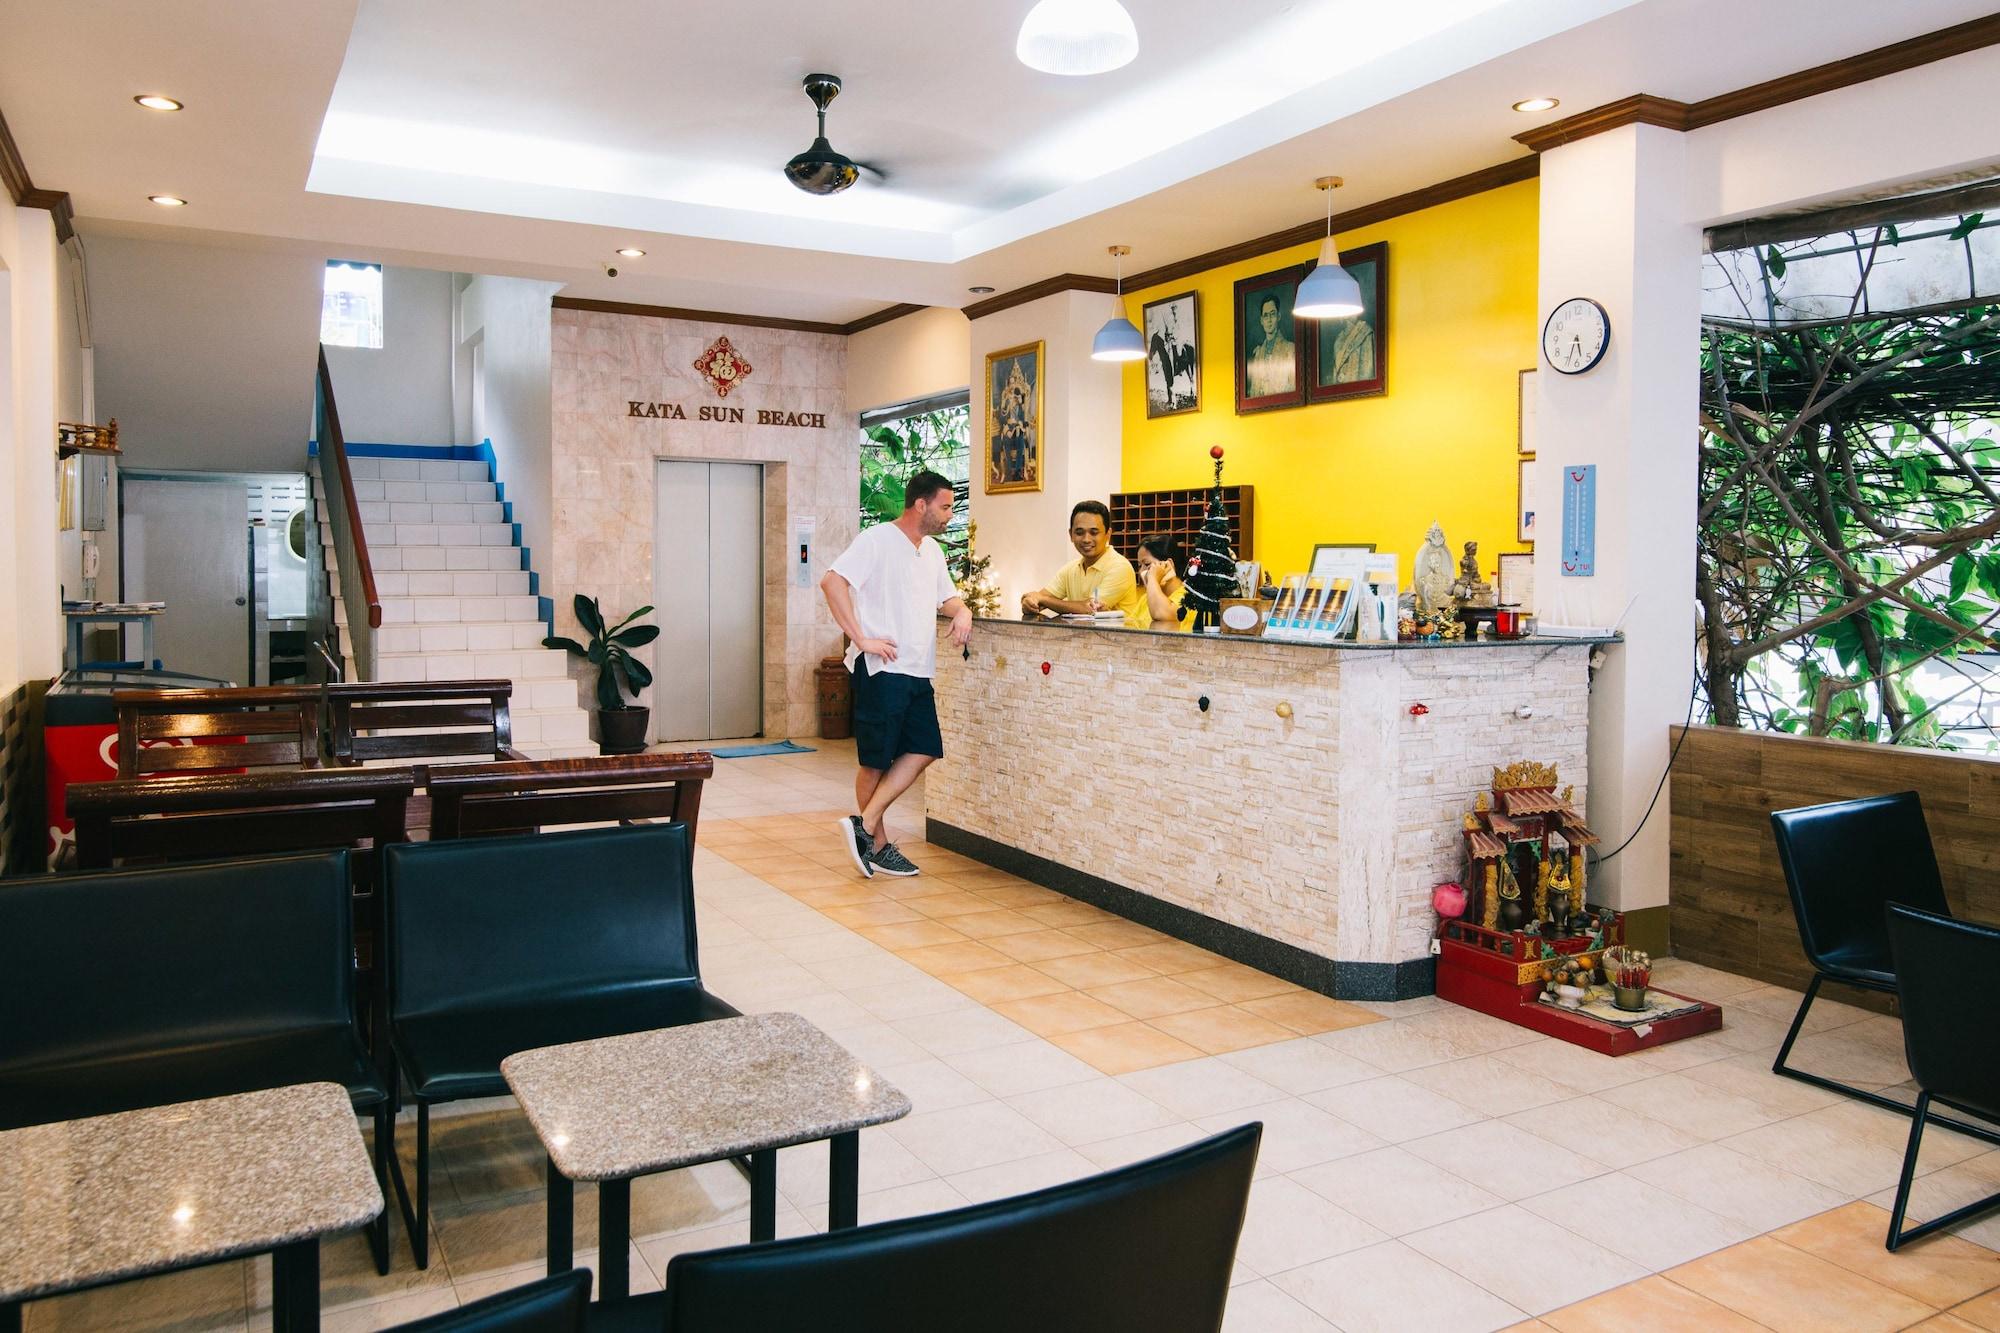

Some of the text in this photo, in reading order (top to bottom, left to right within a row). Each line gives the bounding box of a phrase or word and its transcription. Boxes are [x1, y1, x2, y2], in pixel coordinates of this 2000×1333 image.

[1565, 310, 1571, 320] 11
[1574, 305, 1582, 315] 12
[1556, 321, 1563, 331] 10
[1597, 328, 1602, 338] 3
[1553, 335, 1559, 345] 9
[1595, 342, 1600, 350] 4
[1555, 348, 1560, 357] 8
[1585, 352, 1592, 362] 5
[1563, 355, 1569, 366] 7
[1574, 359, 1580, 368] 6
[628, 401, 826, 429] KATA SUN BEACH
